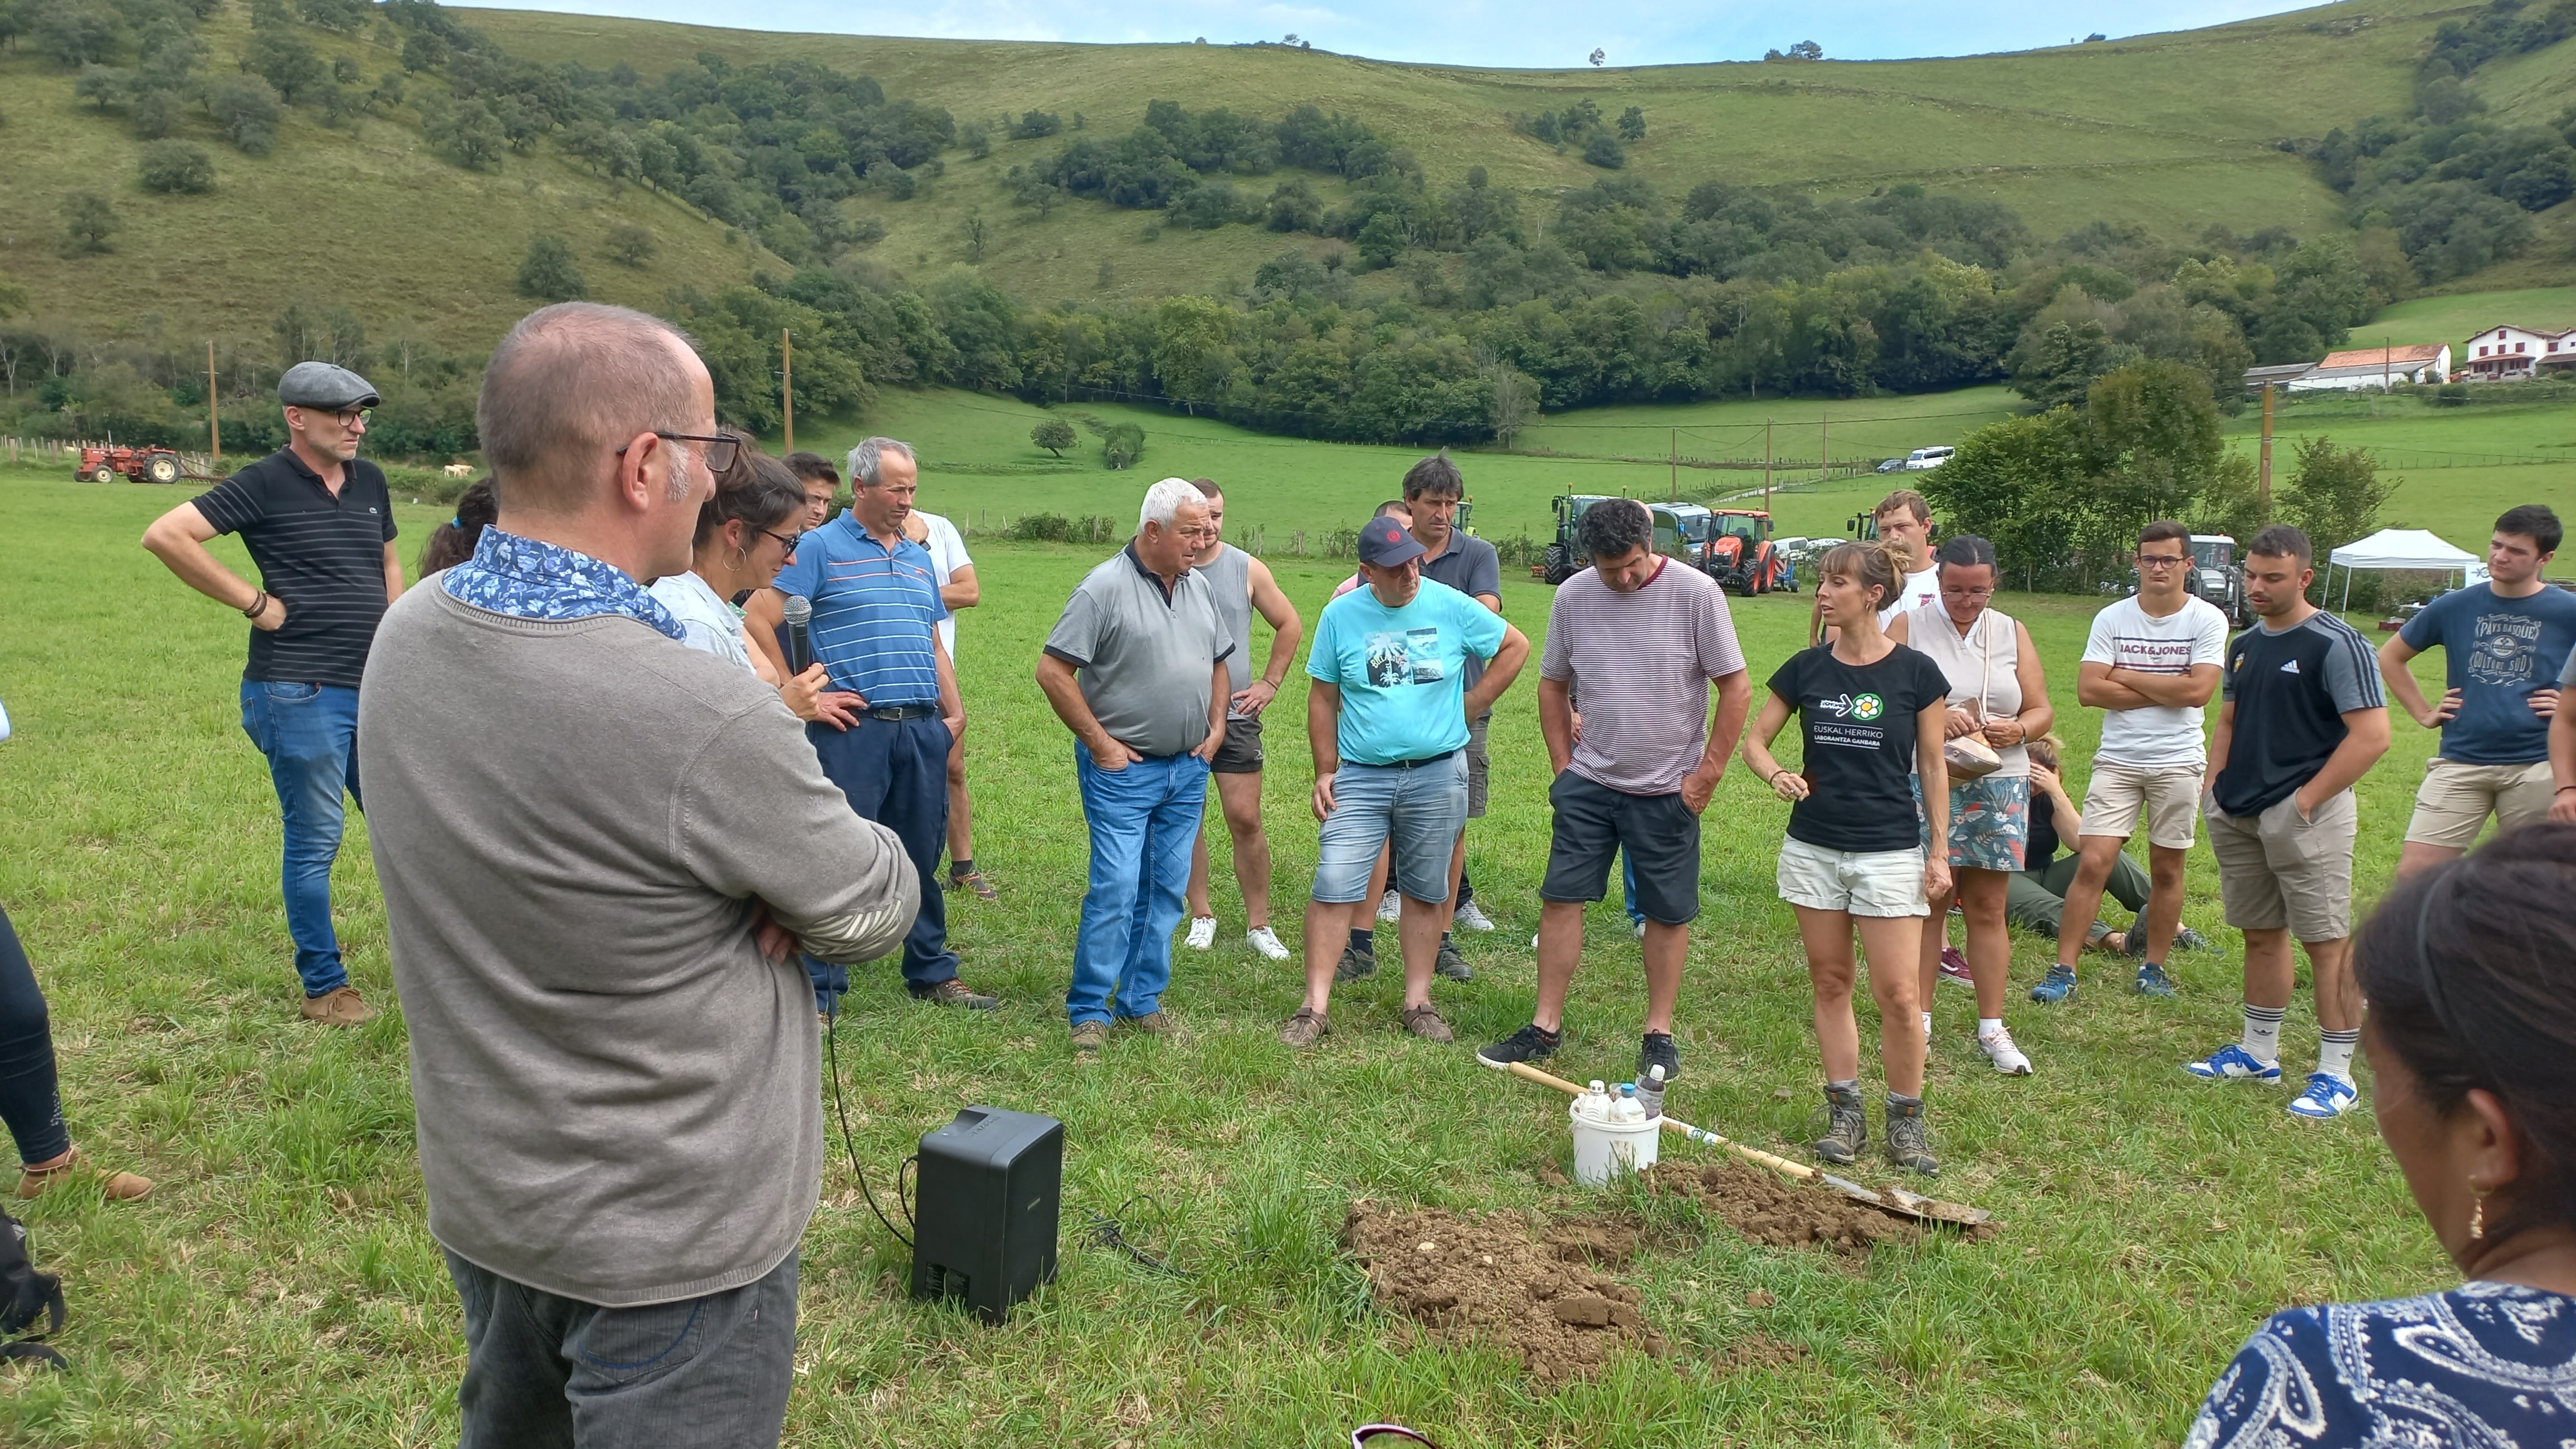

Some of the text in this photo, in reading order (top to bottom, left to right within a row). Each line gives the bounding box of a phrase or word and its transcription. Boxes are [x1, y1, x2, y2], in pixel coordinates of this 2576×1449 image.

[2480, 622, 2536, 640] PAYS BASQUE
[2120, 644, 2192, 655] JACK&JONES
[2473, 651, 2526, 672] CULTURE SUD
[1814, 725, 1884, 739] EUSKAL HERRIKO
[1852, 738, 1881, 747] GANBARA
